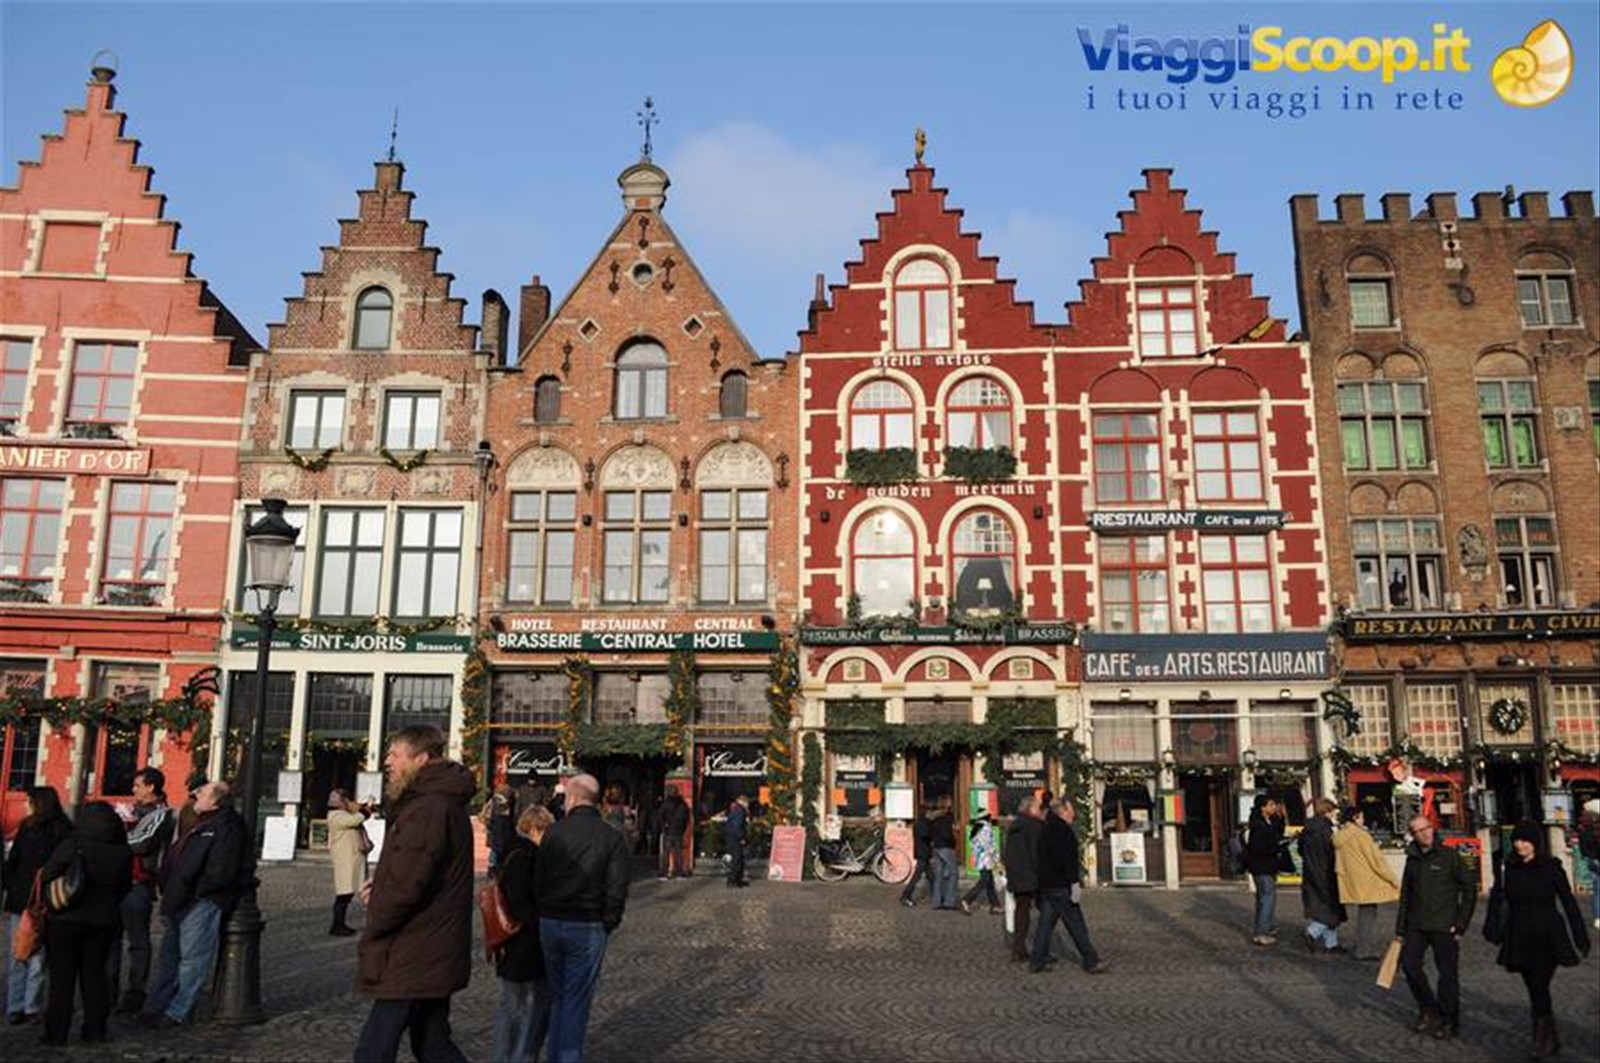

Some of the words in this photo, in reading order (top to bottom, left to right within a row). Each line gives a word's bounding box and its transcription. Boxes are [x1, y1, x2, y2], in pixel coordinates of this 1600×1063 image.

[826, 486, 846, 500] de
[866, 484, 931, 500] gouden
[955, 481, 1036, 497] meermin
[1092, 512, 1198, 527] RESTAURANT
[1254, 514, 1279, 526] ARTS
[510, 617, 555, 630] HOTEL
[581, 617, 668, 631] RESTAURANT
[694, 617, 756, 631] CENTRAL
[1354, 617, 1496, 635] RESTAURANT
[1507, 616, 1536, 631] LA
[300, 634, 407, 651] SINT-JORIS
[497, 633, 582, 649] BRASSERIE
[693, 632, 745, 649] HOTEL
[1135, 664, 1160, 676] DES
[711, 751, 762, 769] Central
